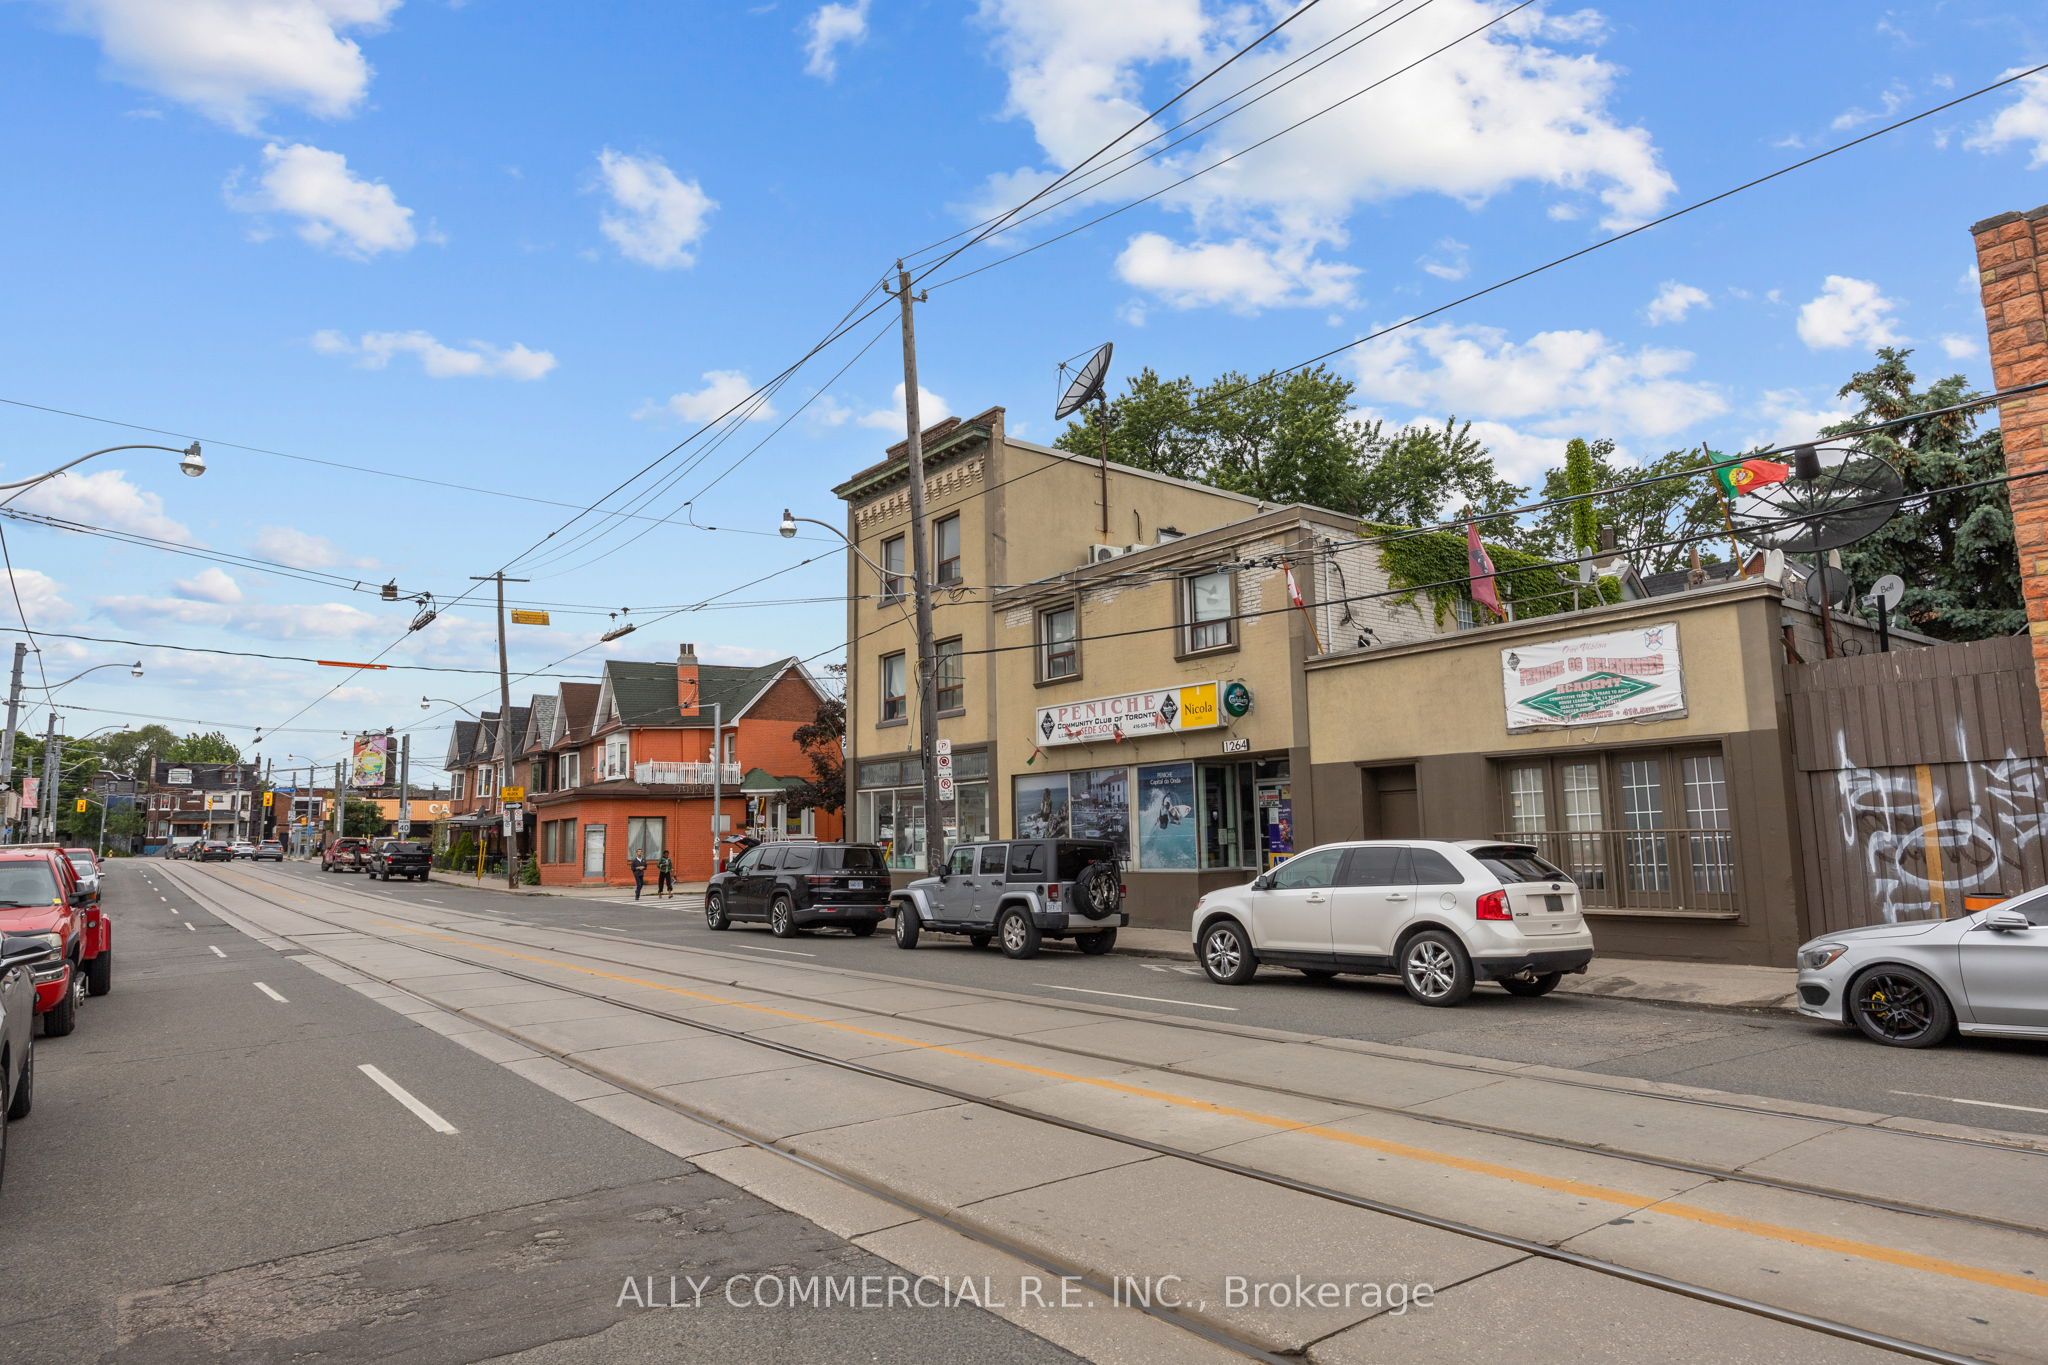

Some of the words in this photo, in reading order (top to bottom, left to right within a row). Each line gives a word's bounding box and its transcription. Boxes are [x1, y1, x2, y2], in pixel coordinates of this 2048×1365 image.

[1881, 583, 1894, 593] Bell
[1519, 660, 1565, 686] PENICHE
[1586, 654, 1664, 676] BELENENSES
[1556, 678, 1622, 694] ACADEMY
[1058, 695, 1156, 722] PENICHE
[1184, 701, 1213, 715] Nicola
[1058, 720, 1094, 729] COMMUNITY
[1125, 711, 1157, 720] TORONTO
[1080, 726, 1097, 735] SEDE
[1226, 740, 1247, 751] 1264
